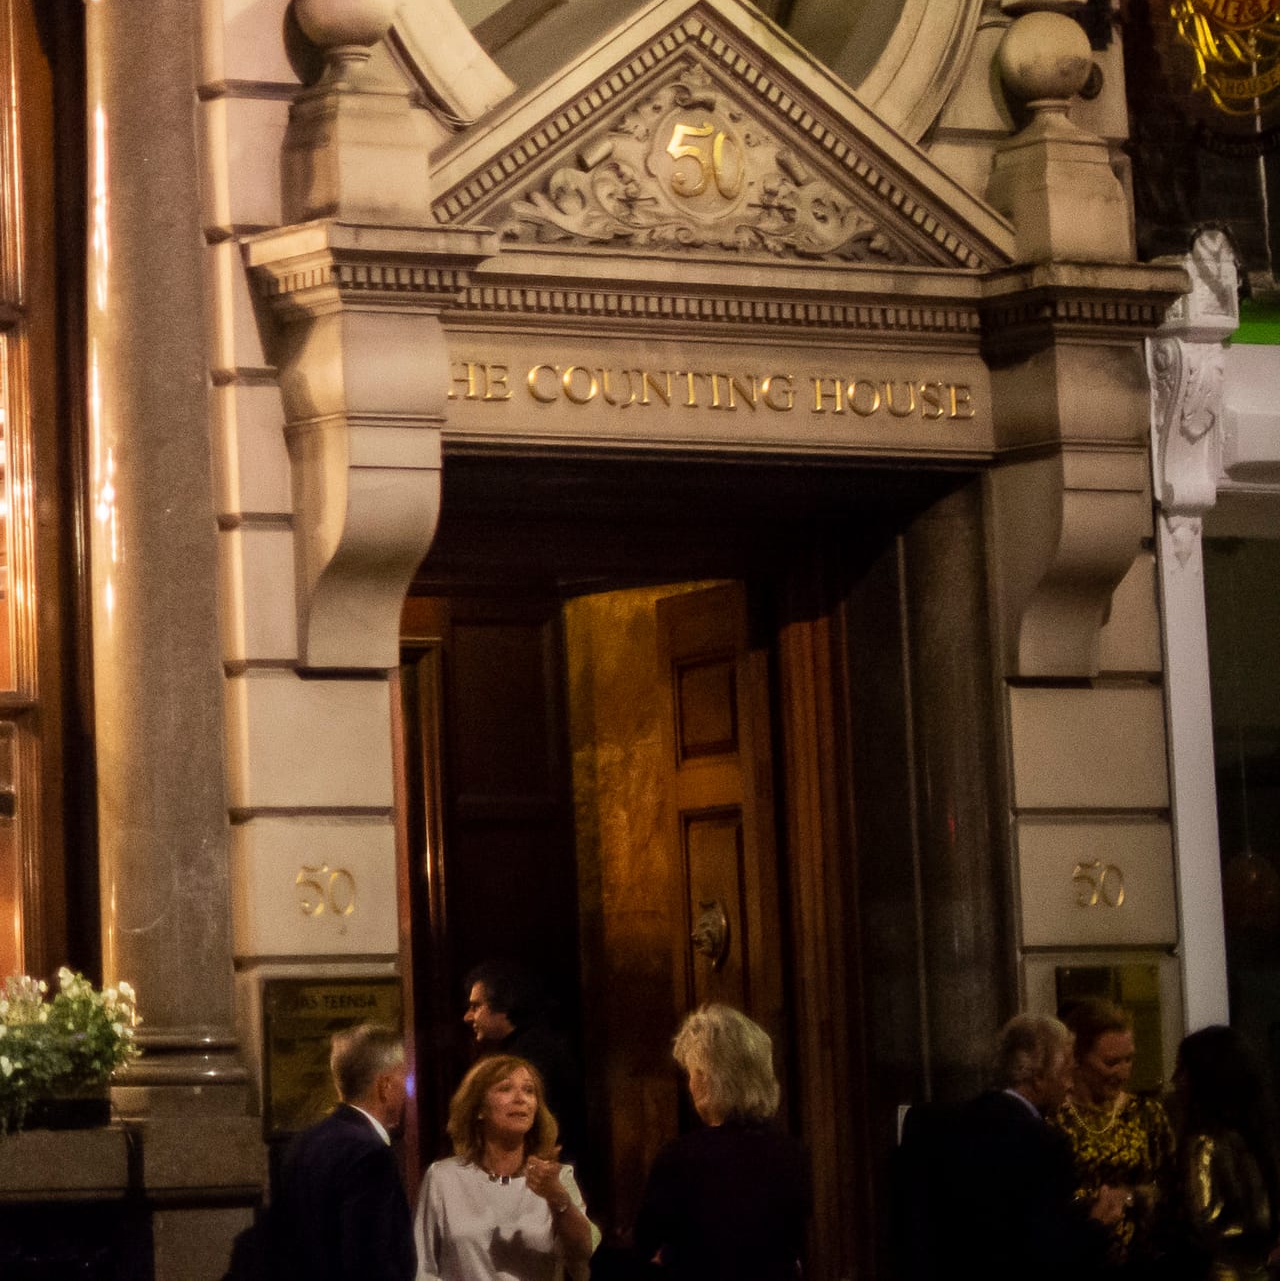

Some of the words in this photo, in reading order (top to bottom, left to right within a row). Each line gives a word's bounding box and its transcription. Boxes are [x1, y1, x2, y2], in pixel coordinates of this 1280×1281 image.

[666, 122, 744, 200] 50
[446, 361, 513, 402] HE
[527, 364, 796, 412] COUNTING
[810, 375, 975, 420] HOUSE
[295, 862, 357, 916] 50
[1072, 858, 1125, 908] 50
